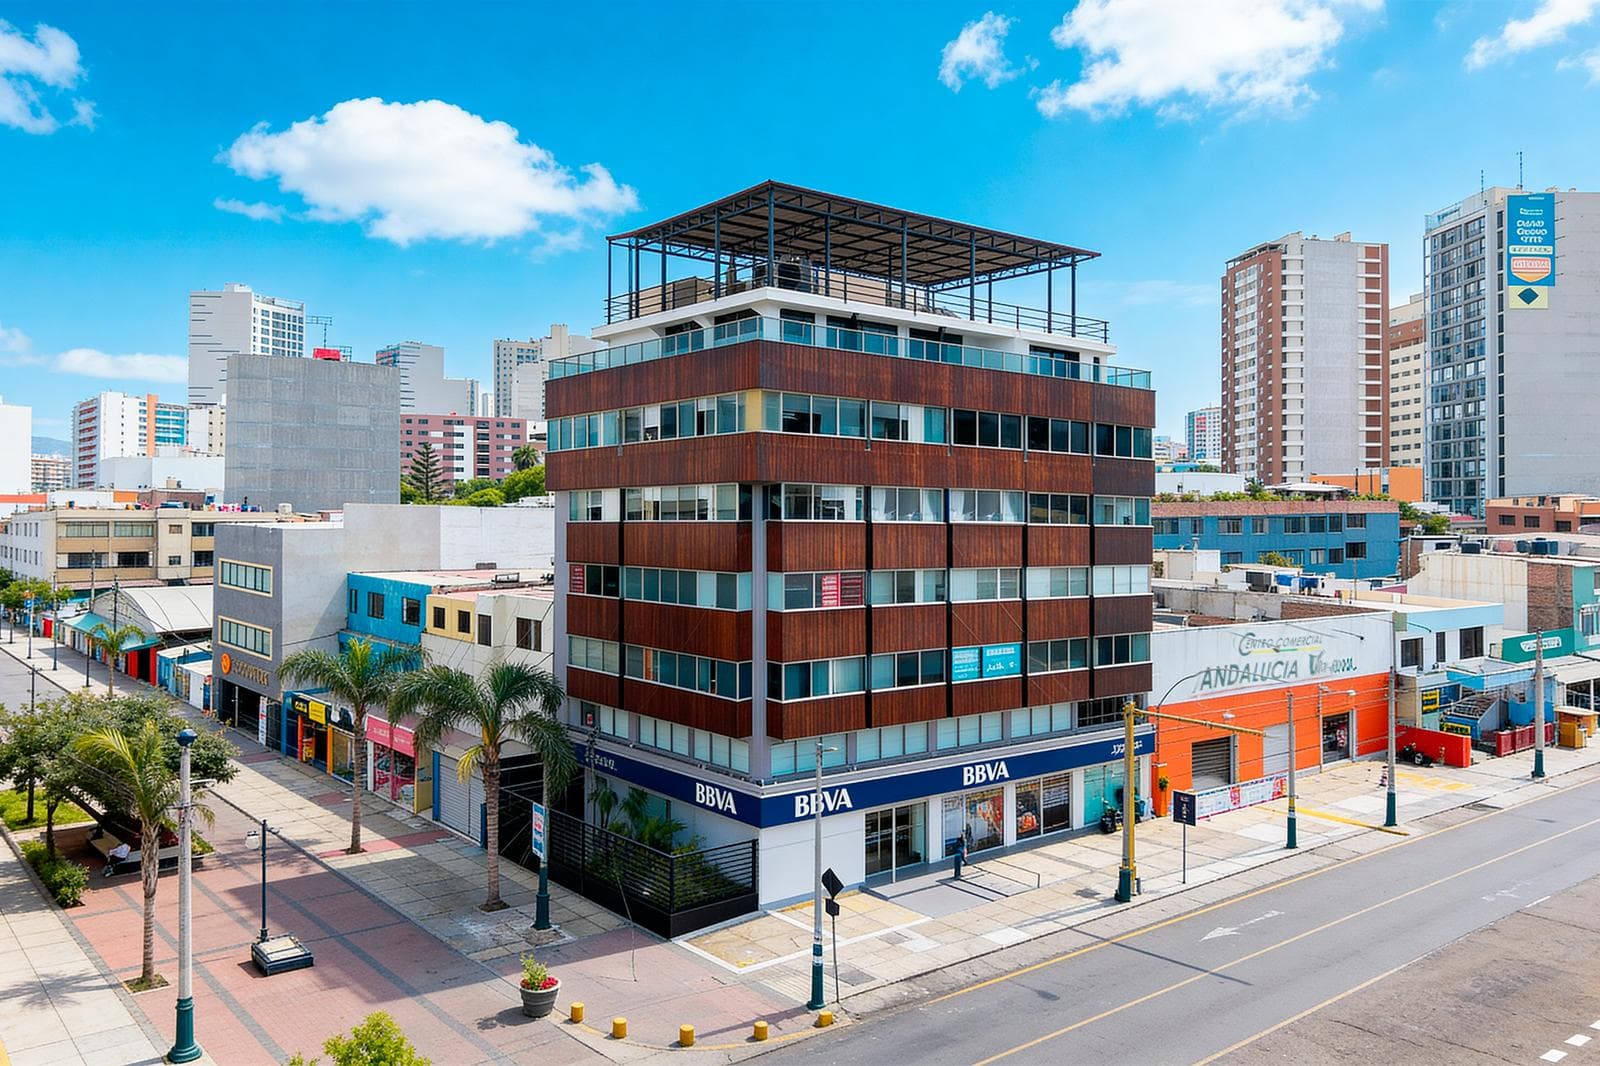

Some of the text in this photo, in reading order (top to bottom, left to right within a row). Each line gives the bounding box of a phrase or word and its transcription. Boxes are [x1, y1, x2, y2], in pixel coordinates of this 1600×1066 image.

[1277, 635, 1323, 648] COMERCIAL
[1200, 659, 1299, 691] ANDALUCIA
[962, 760, 1010, 786] BBVA
[695, 782, 737, 815] BBVA
[794, 787, 853, 818] BBVA
